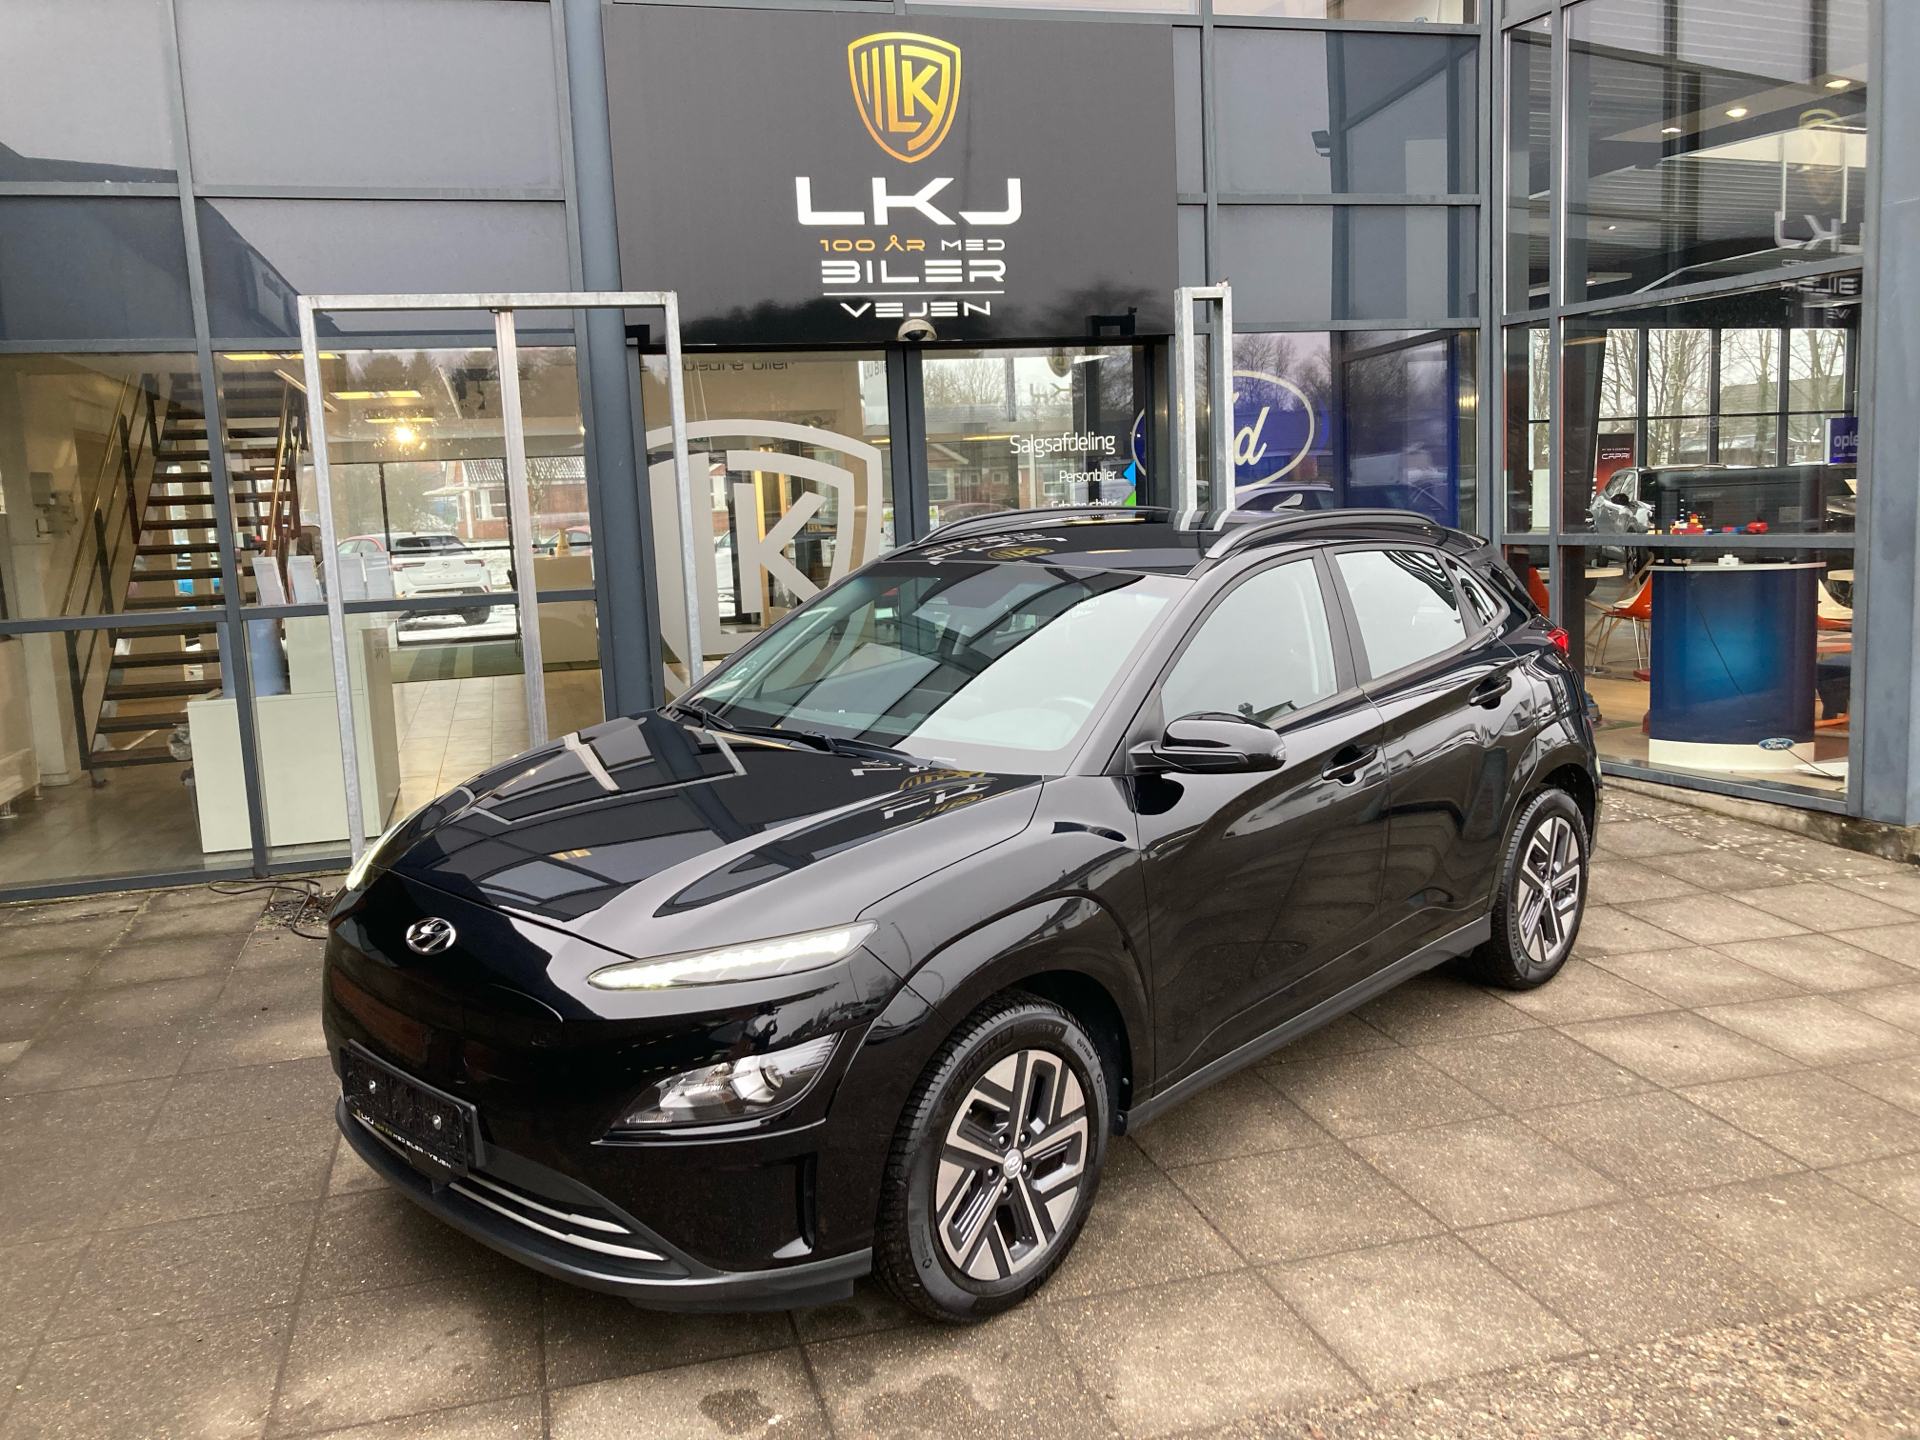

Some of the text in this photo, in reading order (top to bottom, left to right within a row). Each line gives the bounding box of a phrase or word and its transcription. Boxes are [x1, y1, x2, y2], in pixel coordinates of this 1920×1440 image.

[795, 176, 1022, 226] LKJ
[820, 234, 1006, 252] 100 ÅR MED
[821, 259, 1007, 284] BILER
[840, 301, 991, 318] VEJEN
[1010, 432, 1115, 457] Salgsafdeling
[1059, 469, 1117, 483] Personbiler
